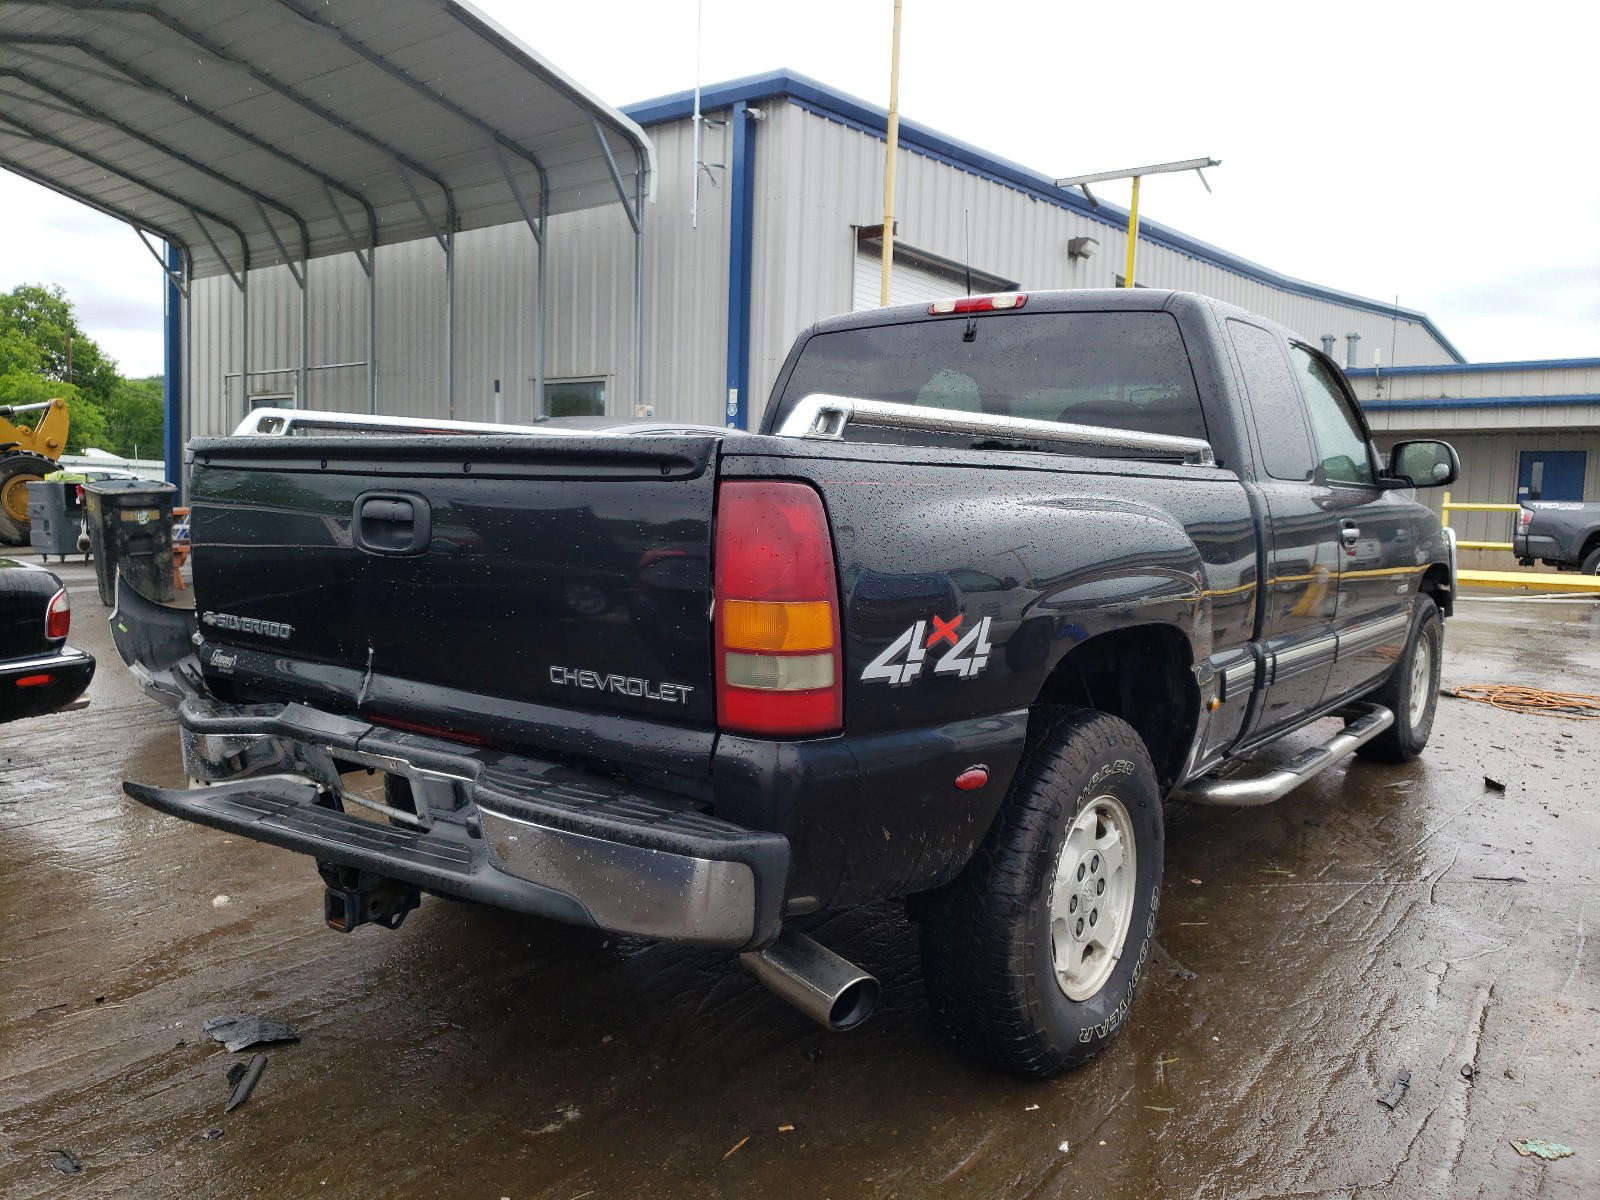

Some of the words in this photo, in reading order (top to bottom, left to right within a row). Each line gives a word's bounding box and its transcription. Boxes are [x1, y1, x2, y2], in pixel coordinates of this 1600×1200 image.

[216, 613, 291, 639] SILVERADO
[549, 665, 695, 705] CHEVROLET
[1079, 886, 1160, 1043] GOODYEAR
